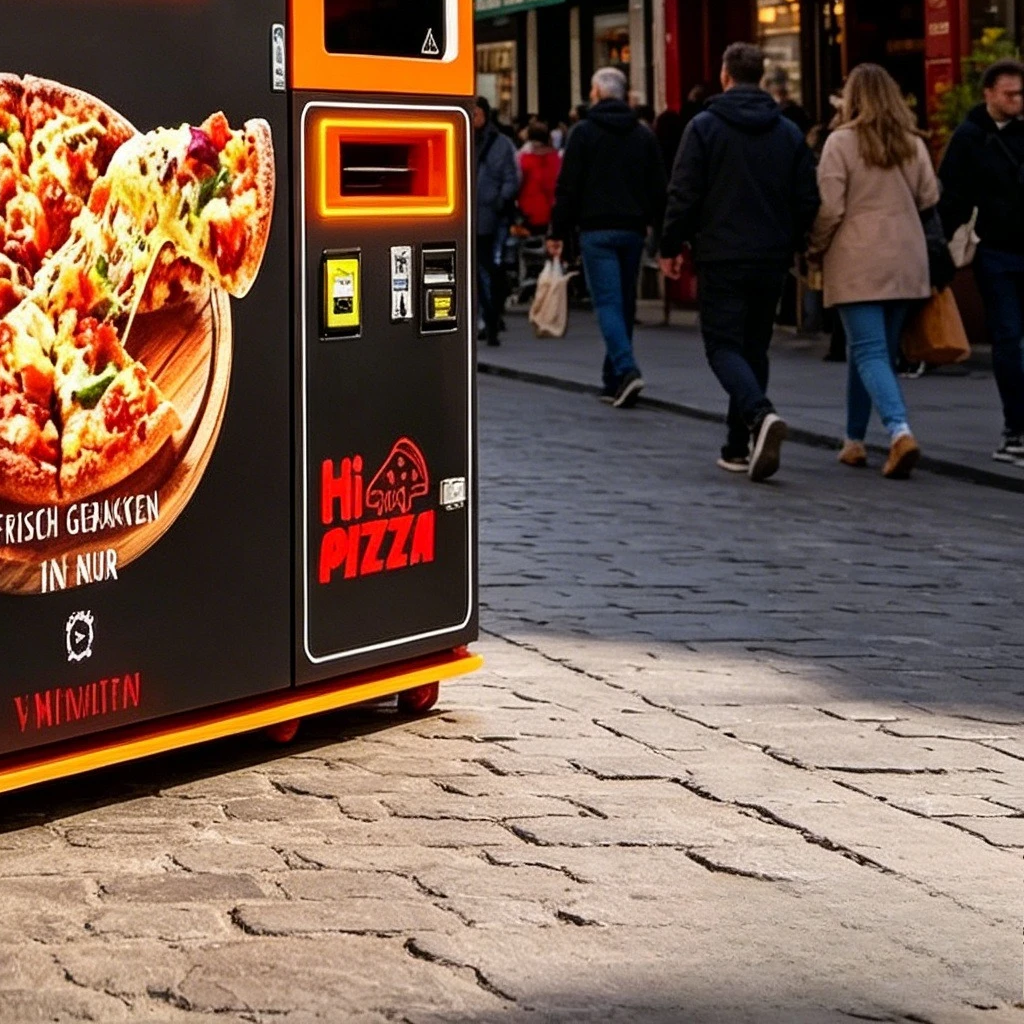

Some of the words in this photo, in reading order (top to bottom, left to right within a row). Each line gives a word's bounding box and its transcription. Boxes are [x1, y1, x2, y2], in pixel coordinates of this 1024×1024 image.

[321, 454, 363, 525] Hi
[77, 548, 119, 586] NUR
[318, 509, 435, 584] PIZZA
